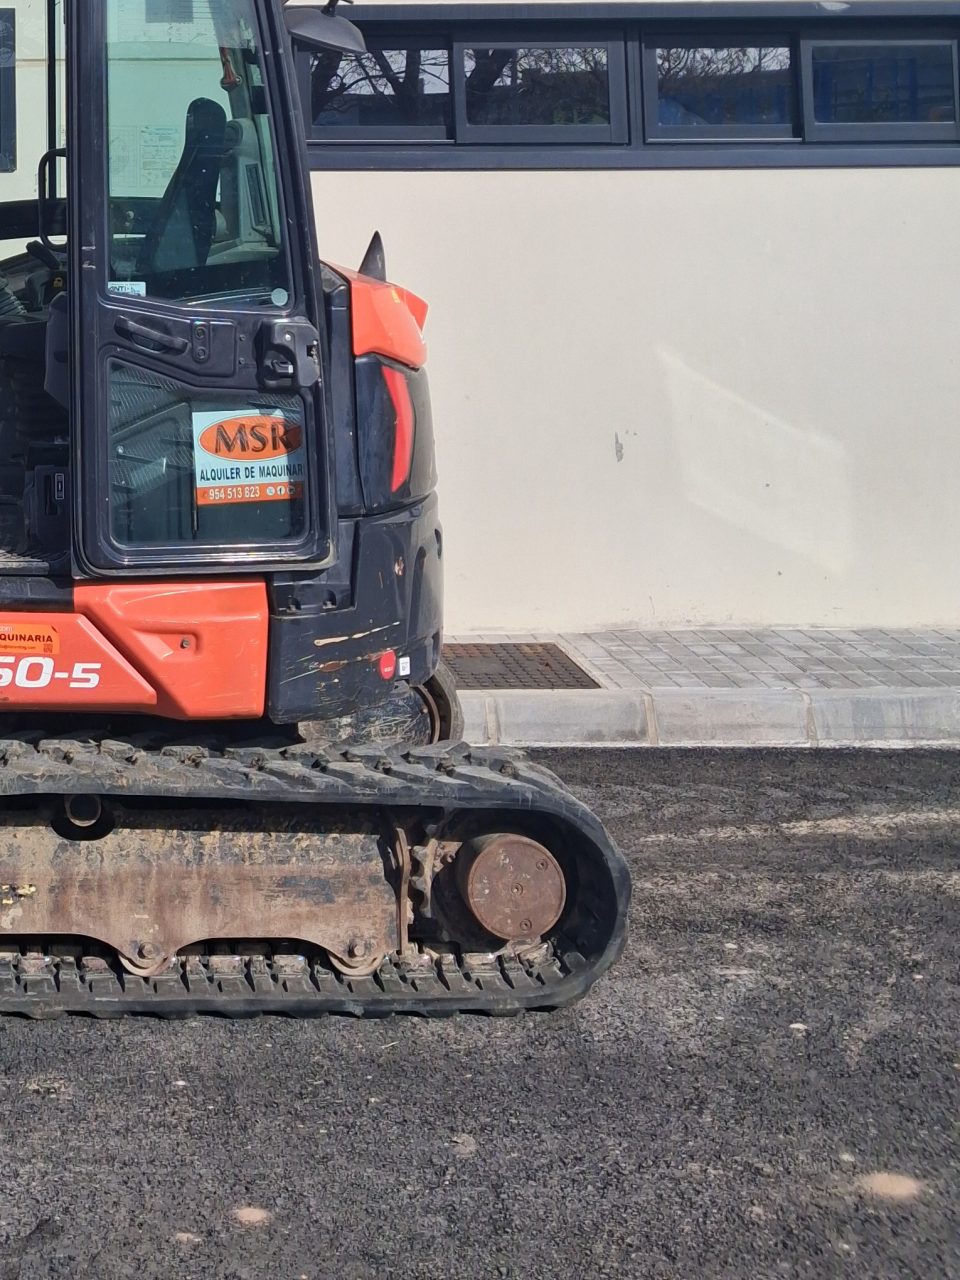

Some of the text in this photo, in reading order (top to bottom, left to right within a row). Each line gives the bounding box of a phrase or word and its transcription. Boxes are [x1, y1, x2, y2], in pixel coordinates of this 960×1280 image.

[215, 423, 295, 454] MSR
[200, 467, 241, 482] ALQUILER
[244, 467, 256, 478] DE
[209, 488, 225, 500] 954
[227, 487, 242, 499] 513
